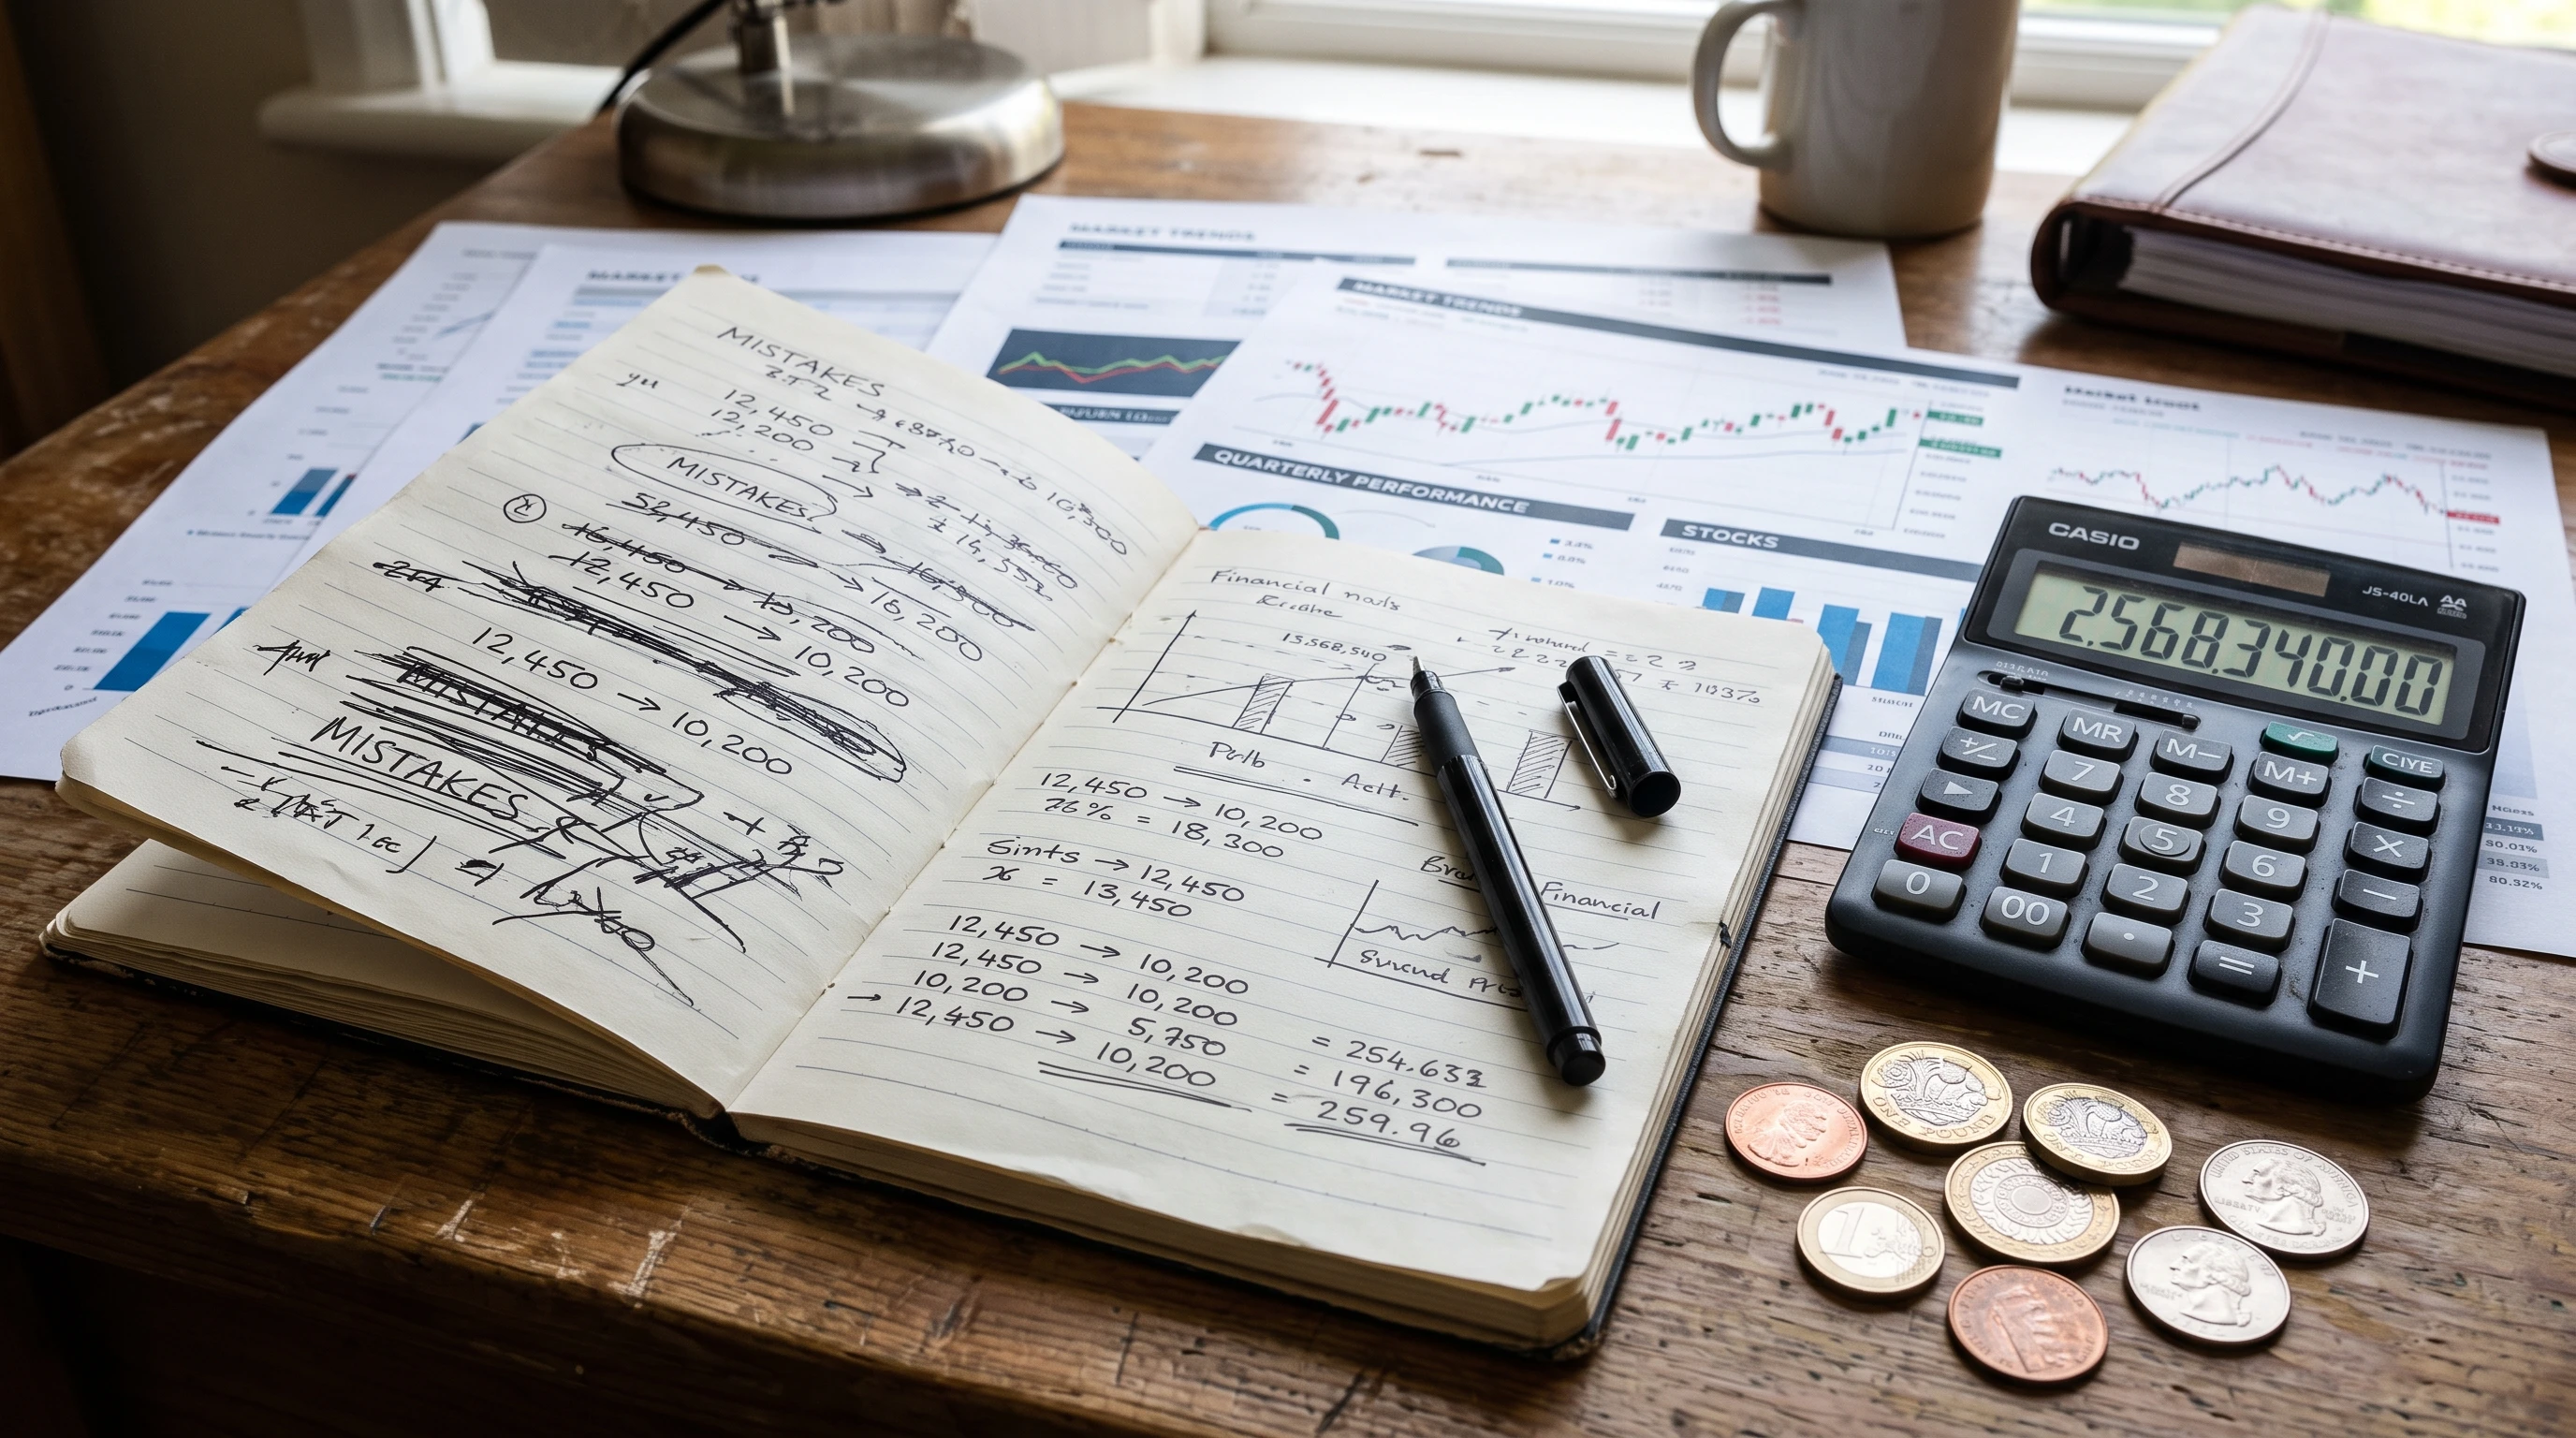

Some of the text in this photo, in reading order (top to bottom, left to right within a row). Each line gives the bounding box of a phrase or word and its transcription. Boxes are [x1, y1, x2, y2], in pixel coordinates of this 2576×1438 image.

[1353, 281, 1440, 304] MARKET
[717, 327, 886, 398] MISTAKES
[710, 409, 814, 451] 12,200
[724, 389, 834, 437] 12,450
[666, 455, 813, 522] MISTAKES
[1214, 449, 1530, 514] QUARTERLY PERFORMANCE
[1681, 523, 1779, 550] STOCKS
[2047, 521, 2141, 551] CASIO
[1210, 568, 1330, 597] Financial
[2362, 585, 2429, 608] JS-40LA
[569, 550, 910, 708] 12,450 10,200
[471, 626, 794, 777] 12,450 10,200
[1971, 696, 2027, 720] MC
[2071, 716, 2123, 743] MR
[310, 715, 530, 822] MISTAKES
[2071, 760, 2097, 783] 7
[2263, 760, 2318, 786] M+
[1039, 770, 1325, 843] 12,450 10,200
[2164, 783, 2192, 808] 8
[2049, 805, 2076, 829] 4
[2264, 806, 2291, 830] 9
[1169, 820, 1284, 860] 18,300
[1910, 824, 1966, 851] AC
[2149, 828, 2179, 852] 5
[2039, 851, 2055, 875] 1
[2251, 853, 2277, 878] 6
[1082, 878, 1193, 920] 13,450
[1139, 863, 1246, 904] 12,450
[1539, 880, 1662, 920] Financial
[1905, 871, 1932, 896] 0
[2131, 874, 2160, 902] 2
[1999, 895, 2051, 927] 00
[2236, 901, 2265, 928] 3
[947, 913, 1251, 997] 12,450 10,200
[931, 941, 1239, 1030] 12,450 10,200
[913, 968, 1227, 1060] 10,200 5,750
[895, 995, 1217, 1090] 12,450 10,200
[1332, 1069, 1484, 1120] 196,300
[1315, 1099, 1462, 1151] 259.96
[1872, 1096, 1997, 1139] ONE POUND
